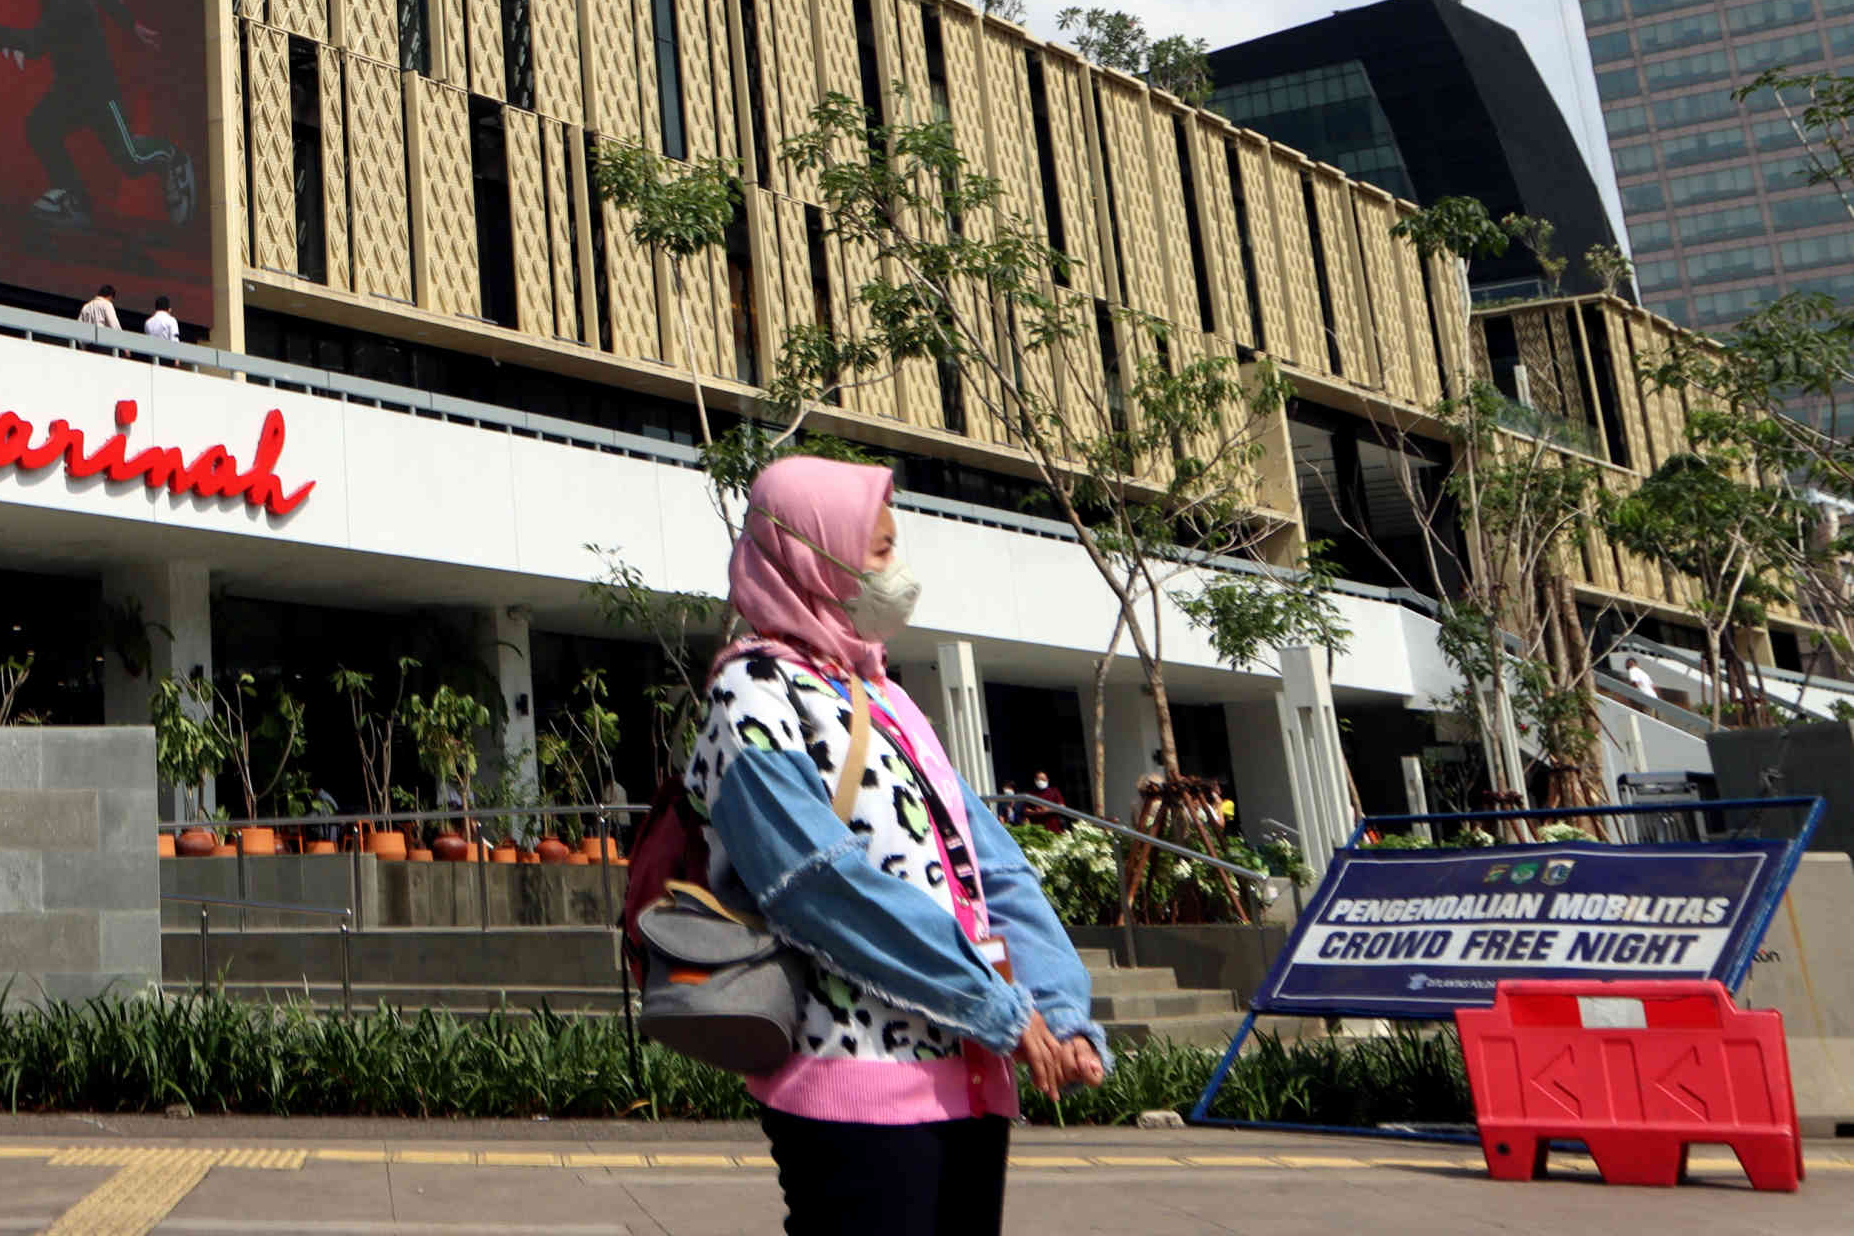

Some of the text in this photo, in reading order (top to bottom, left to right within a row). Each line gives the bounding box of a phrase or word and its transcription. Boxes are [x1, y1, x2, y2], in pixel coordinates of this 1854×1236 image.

[1327, 892, 1731, 924] PENGENDALIAN MOBILITAS
[1318, 929, 1701, 964] CROWD FREE NIGHT
